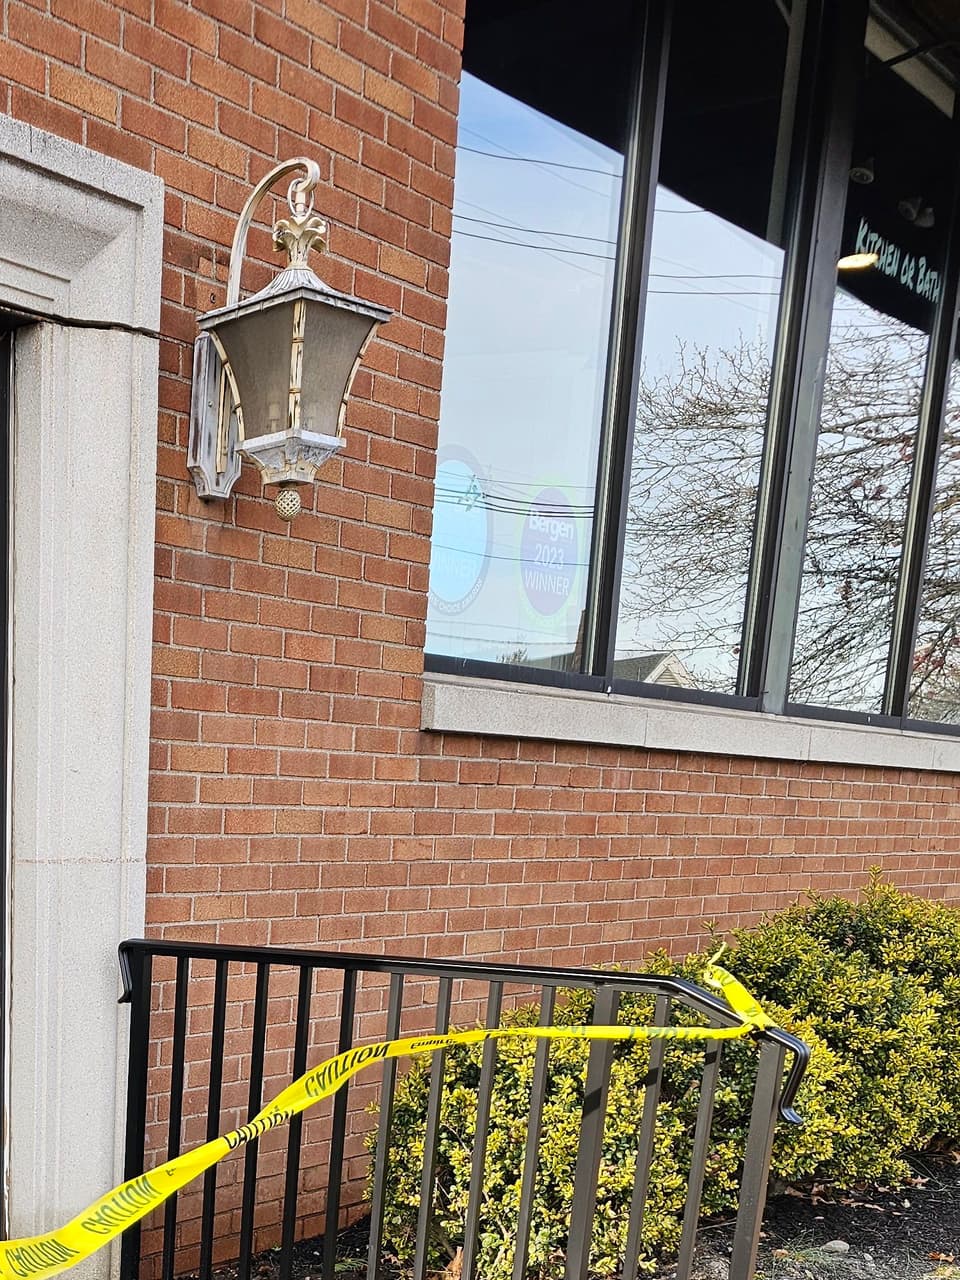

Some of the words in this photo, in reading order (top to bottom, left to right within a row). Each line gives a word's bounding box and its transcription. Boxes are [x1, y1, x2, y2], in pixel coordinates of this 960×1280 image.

[916, 256, 941, 303] BATH
[529, 510, 574, 542] Bergen
[534, 543, 565, 571] 2023
[525, 568, 570, 596] WINNER
